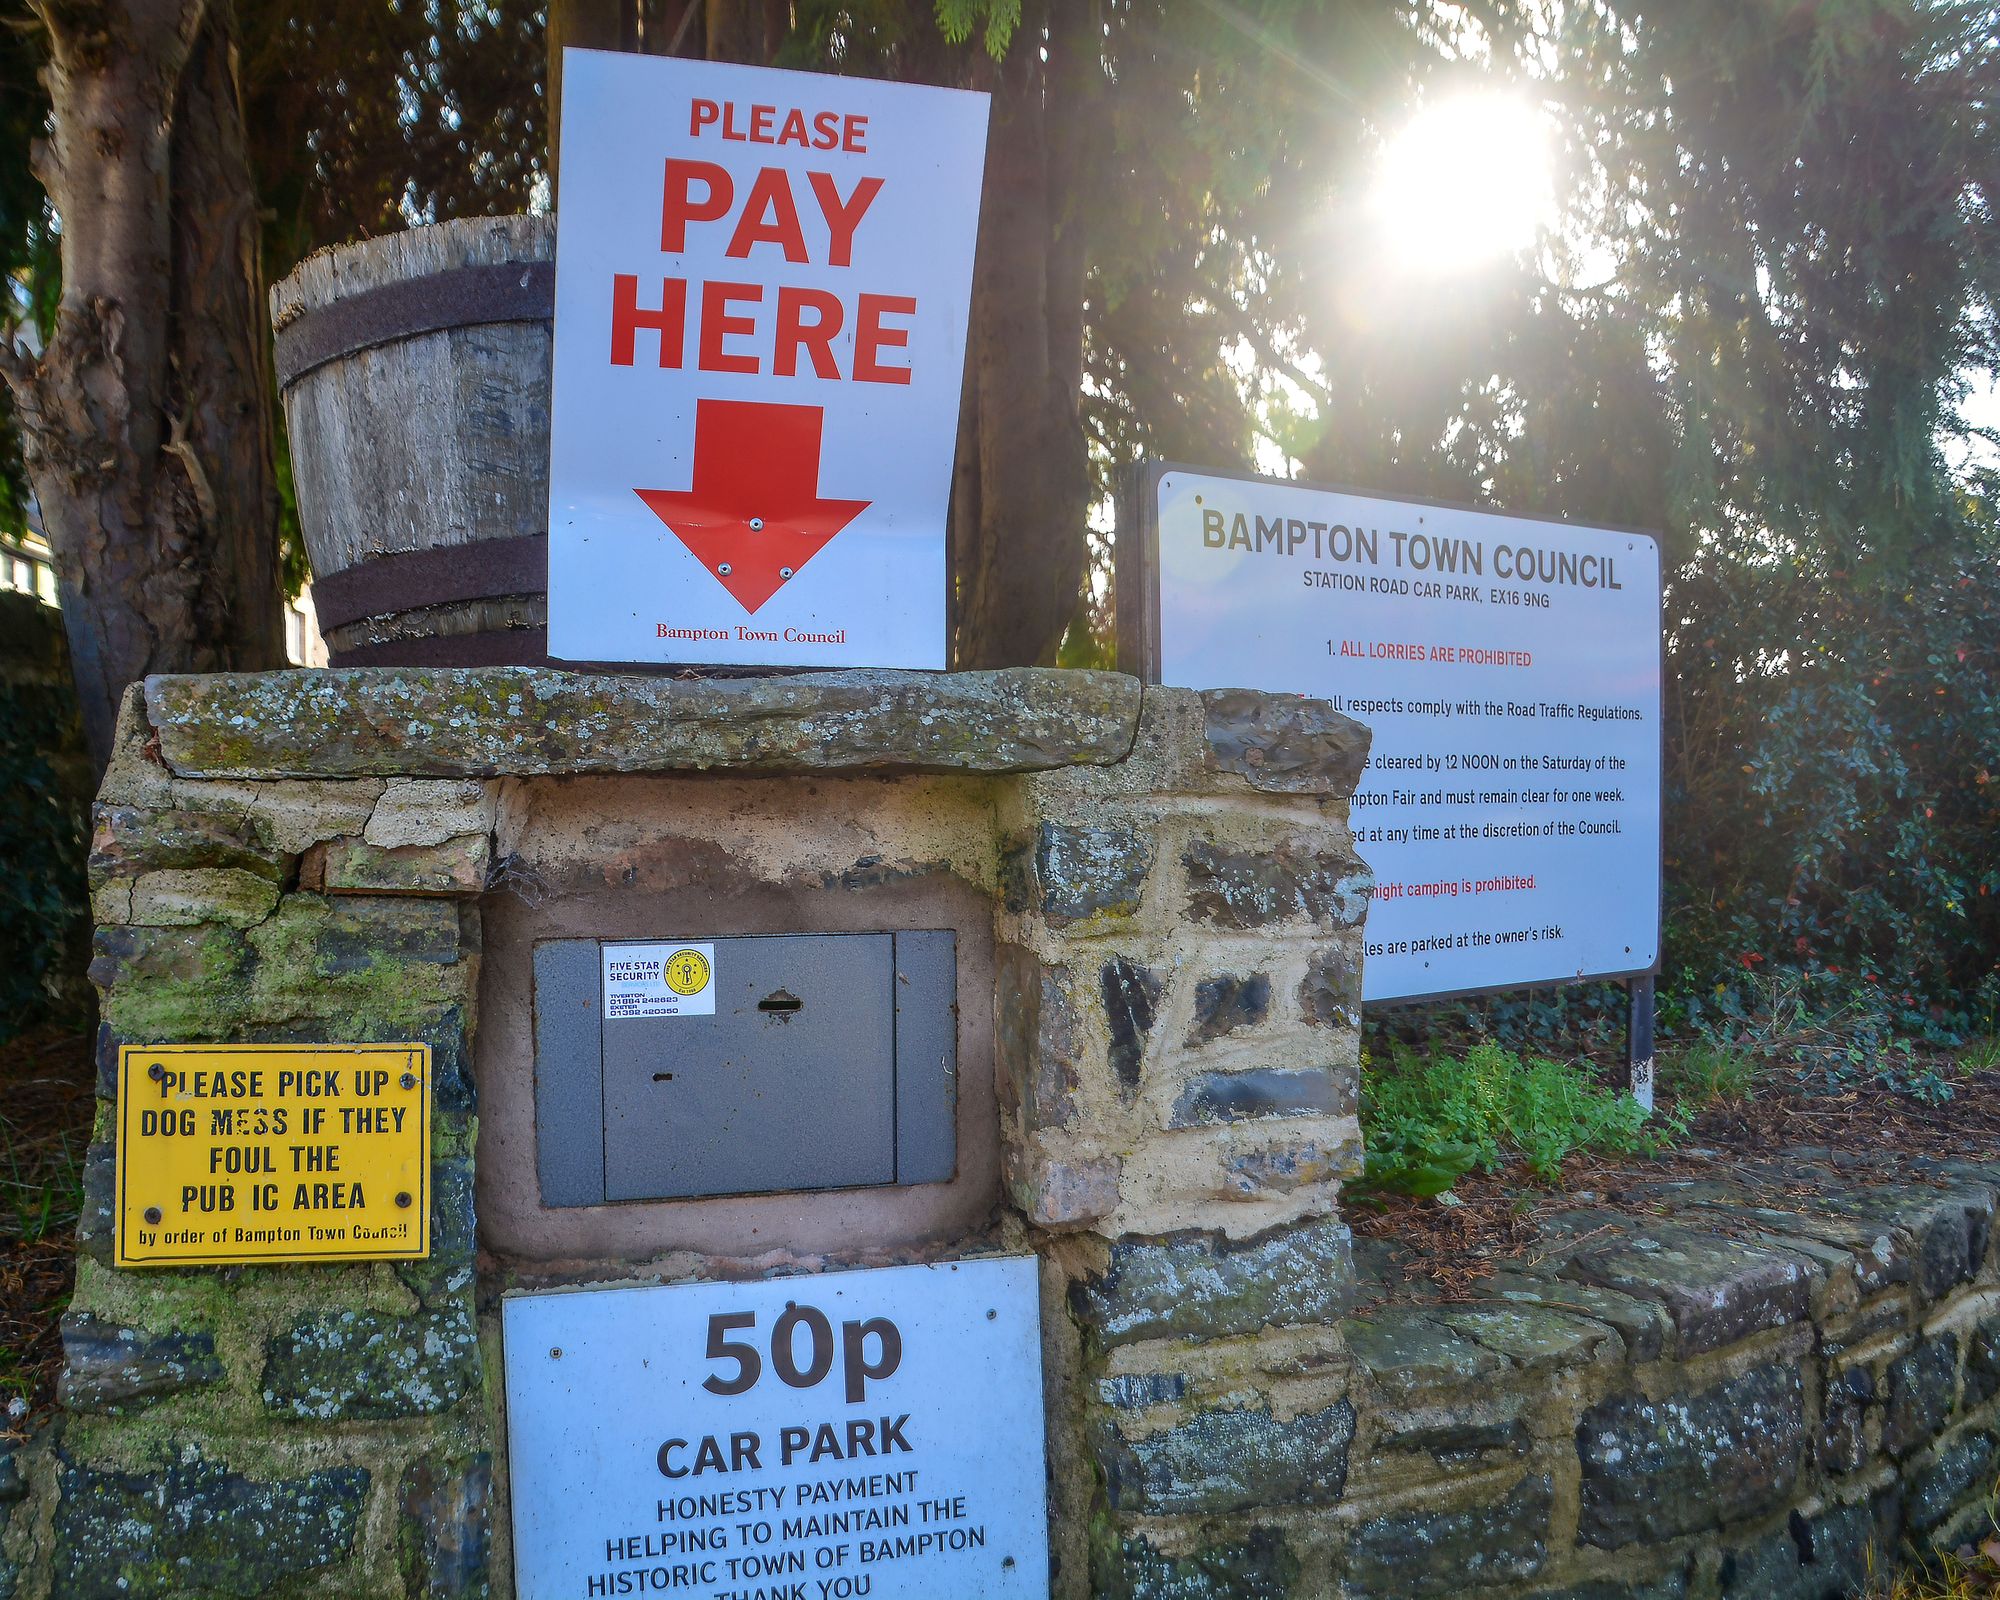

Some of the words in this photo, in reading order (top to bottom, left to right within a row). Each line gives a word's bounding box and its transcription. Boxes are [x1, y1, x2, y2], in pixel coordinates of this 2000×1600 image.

[690, 98, 869, 153] PLEASE
[660, 157, 885, 267] PAY
[610, 273, 917, 385] HERE
[1203, 509, 1378, 566] BAMPTON
[1390, 532, 1482, 576] TOWN
[1494, 545, 1622, 590] COUNCIL
[1303, 570, 1366, 593] STATION
[1370, 576, 1409, 595] ROAD
[1413, 582, 1442, 599] CAR
[1446, 586, 1482, 604] PARK,
[1491, 590, 1520, 605] EX16
[1523, 592, 1550, 608] 9NG
[656, 623, 729, 642] Bampton
[735, 626, 778, 642] Town
[784, 627, 846, 644] Council
[1327, 639, 1336, 655] 1.
[1341, 641, 1365, 657] ALL
[1369, 643, 1425, 661] LORRIES
[1429, 646, 1455, 662] ARE
[1459, 647, 1531, 667] PROHIBITED
[1348, 698, 1402, 715] respects
[1408, 701, 1451, 717] comply
[1456, 701, 1481, 715] with
[1484, 701, 1503, 716] the
[1507, 702, 1535, 717] Road
[1539, 703, 1574, 718] Traffic
[1578, 705, 1643, 721] Regulations.
[1375, 754, 1422, 770] cleared
[1426, 754, 1441, 773] by
[1446, 754, 1457, 770] 12
[1462, 754, 1500, 770] NOON
[1503, 758, 1517, 770] on
[1520, 755, 1538, 770] the
[1542, 755, 1592, 773] Saturday
[1595, 756, 1605, 770] of
[1608, 757, 1626, 770] the
[1392, 790, 1416, 805] Fair
[1420, 790, 1442, 805] and
[1446, 790, 1475, 804] must
[1479, 789, 1518, 804] remain
[1521, 788, 1549, 803] clear
[1553, 788, 1568, 803] for
[1571, 791, 1591, 803] one
[1594, 788, 1624, 802] week.
[1370, 828, 1383, 842] at
[1387, 830, 1408, 845] any
[1413, 825, 1440, 841] time
[1444, 826, 1456, 840] at
[1459, 824, 1479, 839] the
[1482, 822, 1539, 838] discretion
[1543, 822, 1554, 836] of
[1558, 821, 1575, 836] the
[1578, 820, 1622, 835] Council.
[1407, 880, 1458, 899] camping
[1462, 879, 1472, 893] is
[1475, 875, 1537, 895] prohibited.
[1387, 941, 1407, 955] are
[1411, 935, 1453, 955] parked
[1456, 934, 1469, 948] at
[1473, 931, 1490, 946] the
[1495, 926, 1538, 945] owner's
[1541, 924, 1565, 941] risk.
[610, 962, 631, 971] FIVE
[634, 962, 660, 970] STAR
[610, 972, 659, 981] SECURITY
[160, 1070, 264, 1098] PLEASE
[278, 1070, 341, 1097] PICK
[354, 1070, 389, 1097] UP
[141, 1108, 196, 1137] DOG
[210, 1107, 289, 1136] MESS
[302, 1108, 326, 1135] IF
[338, 1106, 407, 1134] THEY
[209, 1146, 276, 1174] FOUL
[289, 1145, 340, 1172] THE
[182, 1183, 279, 1212] PUBIC
[293, 1182, 366, 1211] AREA
[139, 1230, 156, 1247] by
[164, 1229, 205, 1245] order
[213, 1228, 228, 1243] of
[235, 1228, 301, 1245] Bampton
[307, 1226, 345, 1242] Town
[353, 1223, 408, 1240] Council
[701, 1304, 903, 1404] 50p
[656, 1431, 762, 1479] CAR
[780, 1413, 914, 1466] PARK
[657, 1485, 785, 1522] HONESTY
[796, 1470, 919, 1506] PAYMENT
[606, 1528, 727, 1562] HELPING
[736, 1522, 772, 1546] TO
[782, 1503, 909, 1541] MAINTAIN
[917, 1496, 968, 1522] THE
[587, 1561, 717, 1597] HISTORIC
[725, 1549, 805, 1581] TOWN
[815, 1545, 849, 1569] OF
[859, 1525, 986, 1563] BAMPTON
[816, 1573, 871, 1600] YOU
